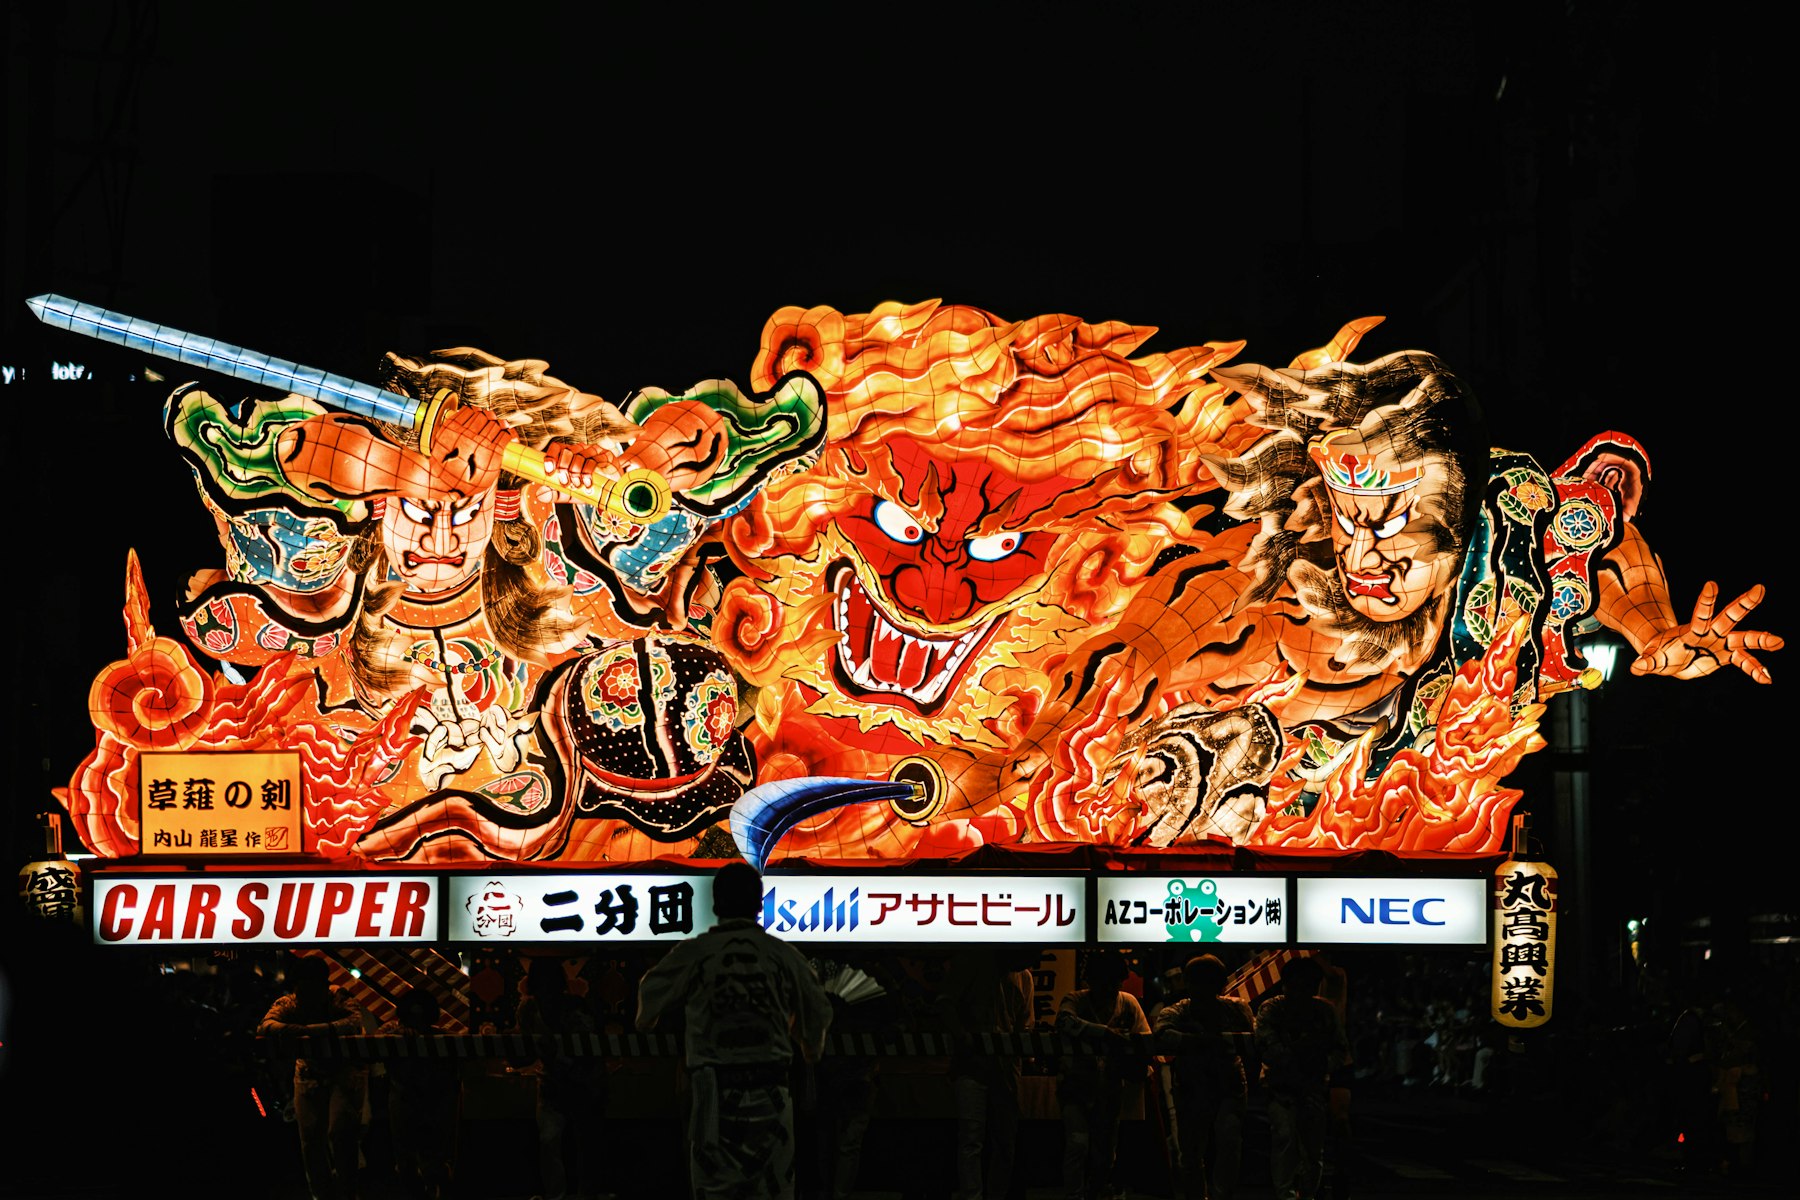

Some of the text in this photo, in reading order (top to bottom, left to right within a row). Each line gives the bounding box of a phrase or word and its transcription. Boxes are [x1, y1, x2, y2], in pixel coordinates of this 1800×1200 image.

[148, 778, 291, 811] 草薙の剣
[99, 881, 431, 942] CAR SUPER
[540, 881, 694, 935] 二分団
[867, 893, 1076, 927] アサヒビール
[1341, 897, 1446, 926] NEC
